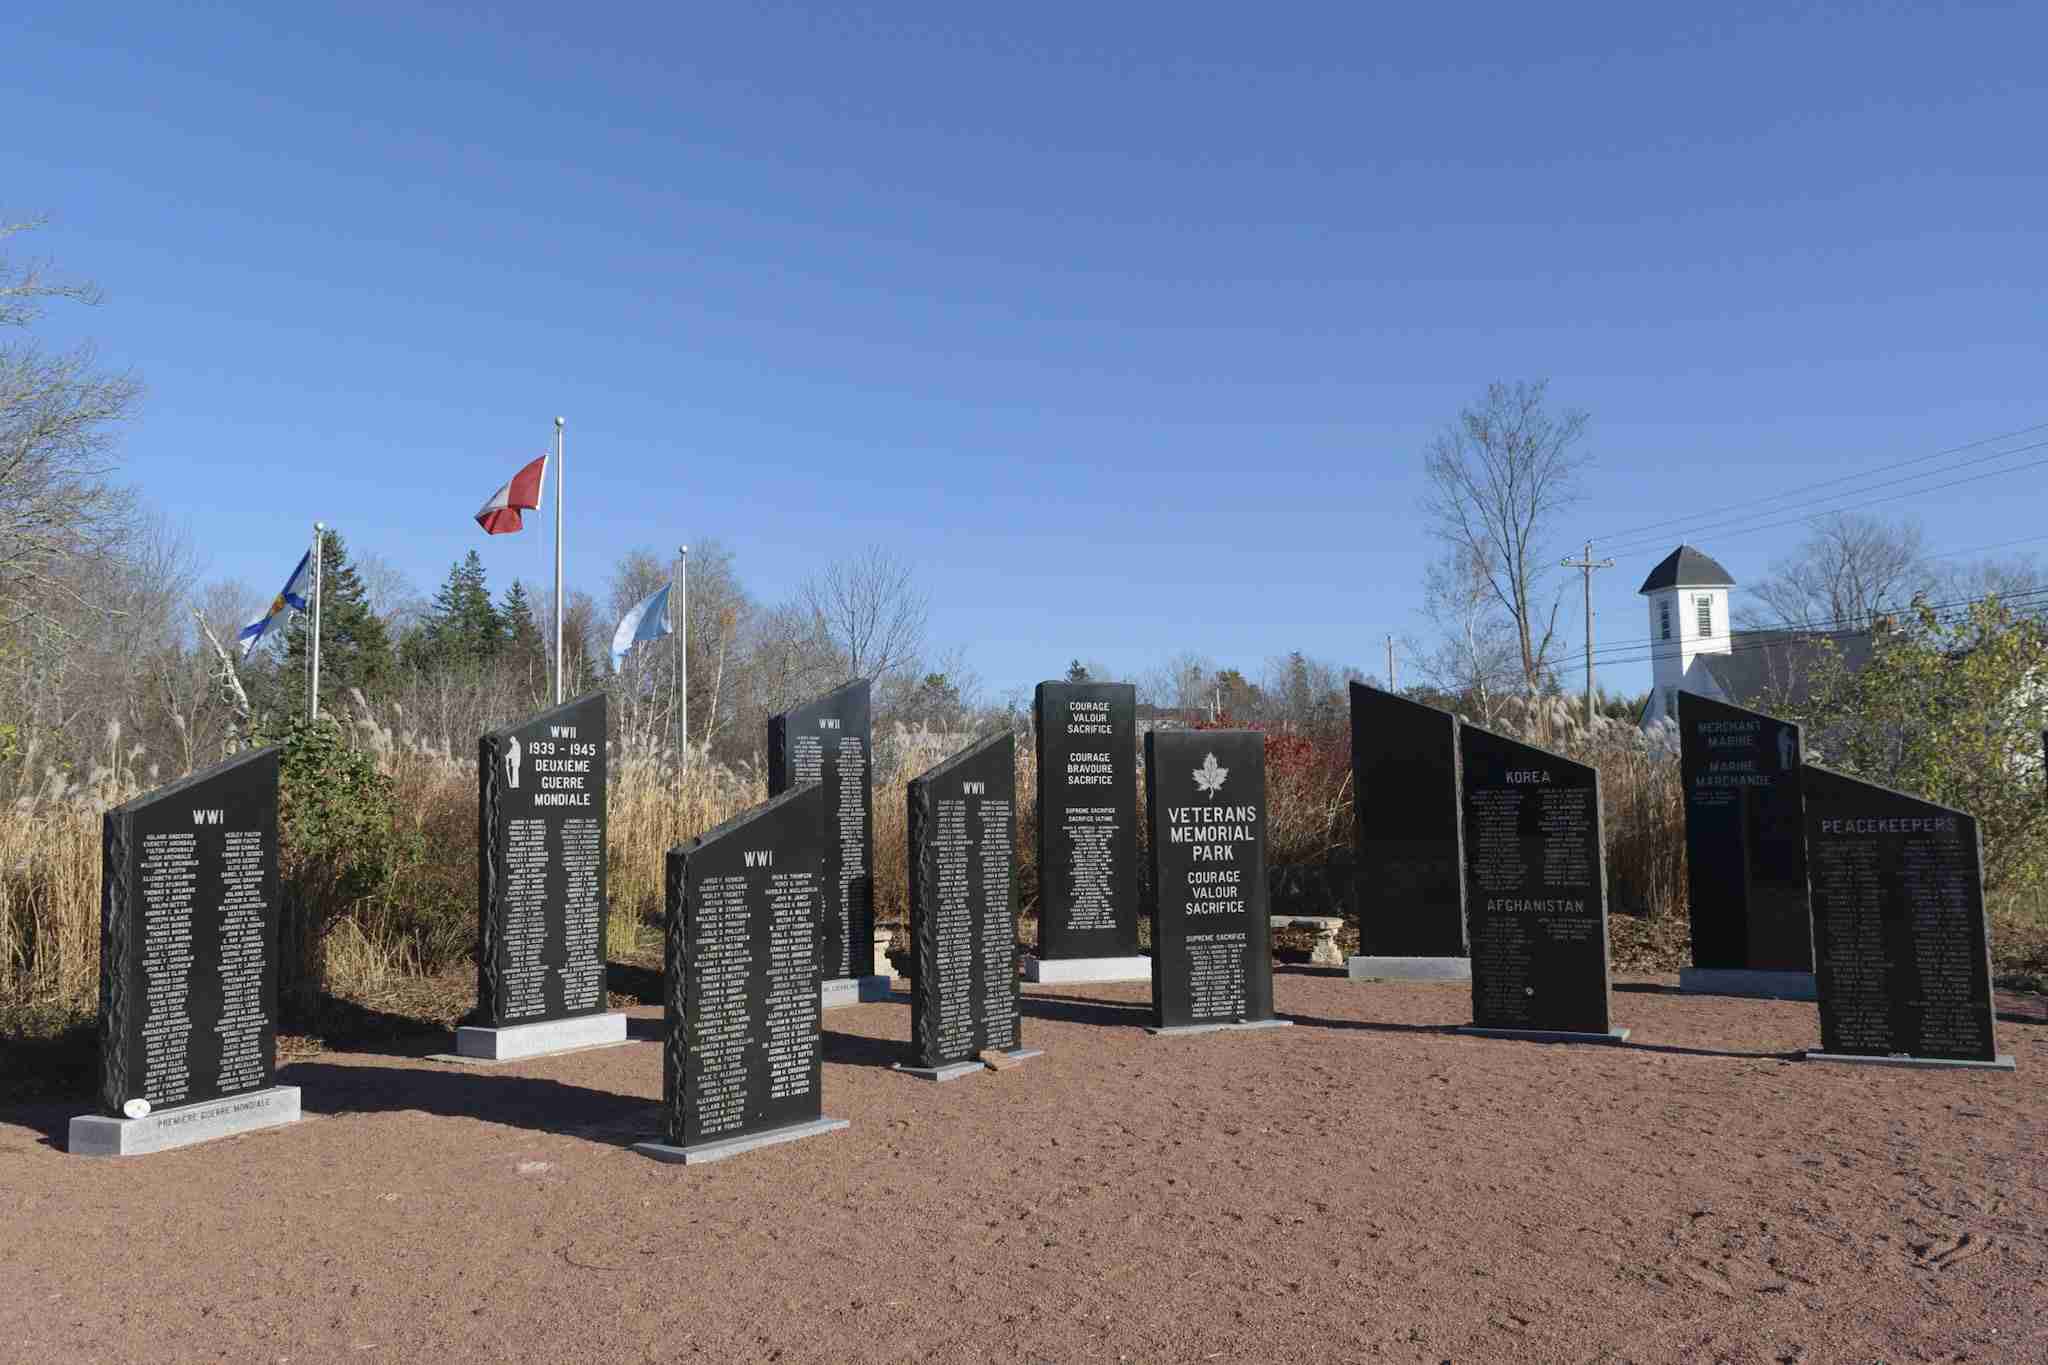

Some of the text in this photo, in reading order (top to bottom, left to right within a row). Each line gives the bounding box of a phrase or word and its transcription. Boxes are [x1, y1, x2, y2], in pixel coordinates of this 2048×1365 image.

[1070, 702, 1111, 711] COURAGE
[1072, 713, 1107, 722] VALOUR
[818, 719, 841, 730] WWII
[1067, 725, 1112, 734] SACRIFICE
[550, 726, 577, 739] WWII
[529, 742, 555, 755] 1939
[569, 743, 596, 756] 1945
[1070, 753, 1111, 762] COURAGE
[1067, 764, 1113, 774] BRAVOURE
[541, 776, 585, 789] GUERRE
[1068, 776, 1113, 785] SACRIFICE
[1505, 770, 1551, 784] KOREA
[962, 782, 985, 795] WWII
[534, 793, 591, 806] MONDIALE
[192, 810, 223, 825] WWI
[1168, 806, 1257, 823] VETERANS
[1822, 817, 1955, 833] PEACEKEEPERS
[1171, 825, 1255, 843] MEMORIAL
[744, 850, 772, 867] WWI
[1193, 845, 1234, 861] PARK
[1187, 870, 1241, 884] COURAGE
[1192, 886, 1238, 899] VALOUR
[1186, 901, 1245, 915] SACRIFICE
[1487, 898, 1585, 913] AFGHANISTAN
[232, 1095, 272, 1113] MONDIALE
